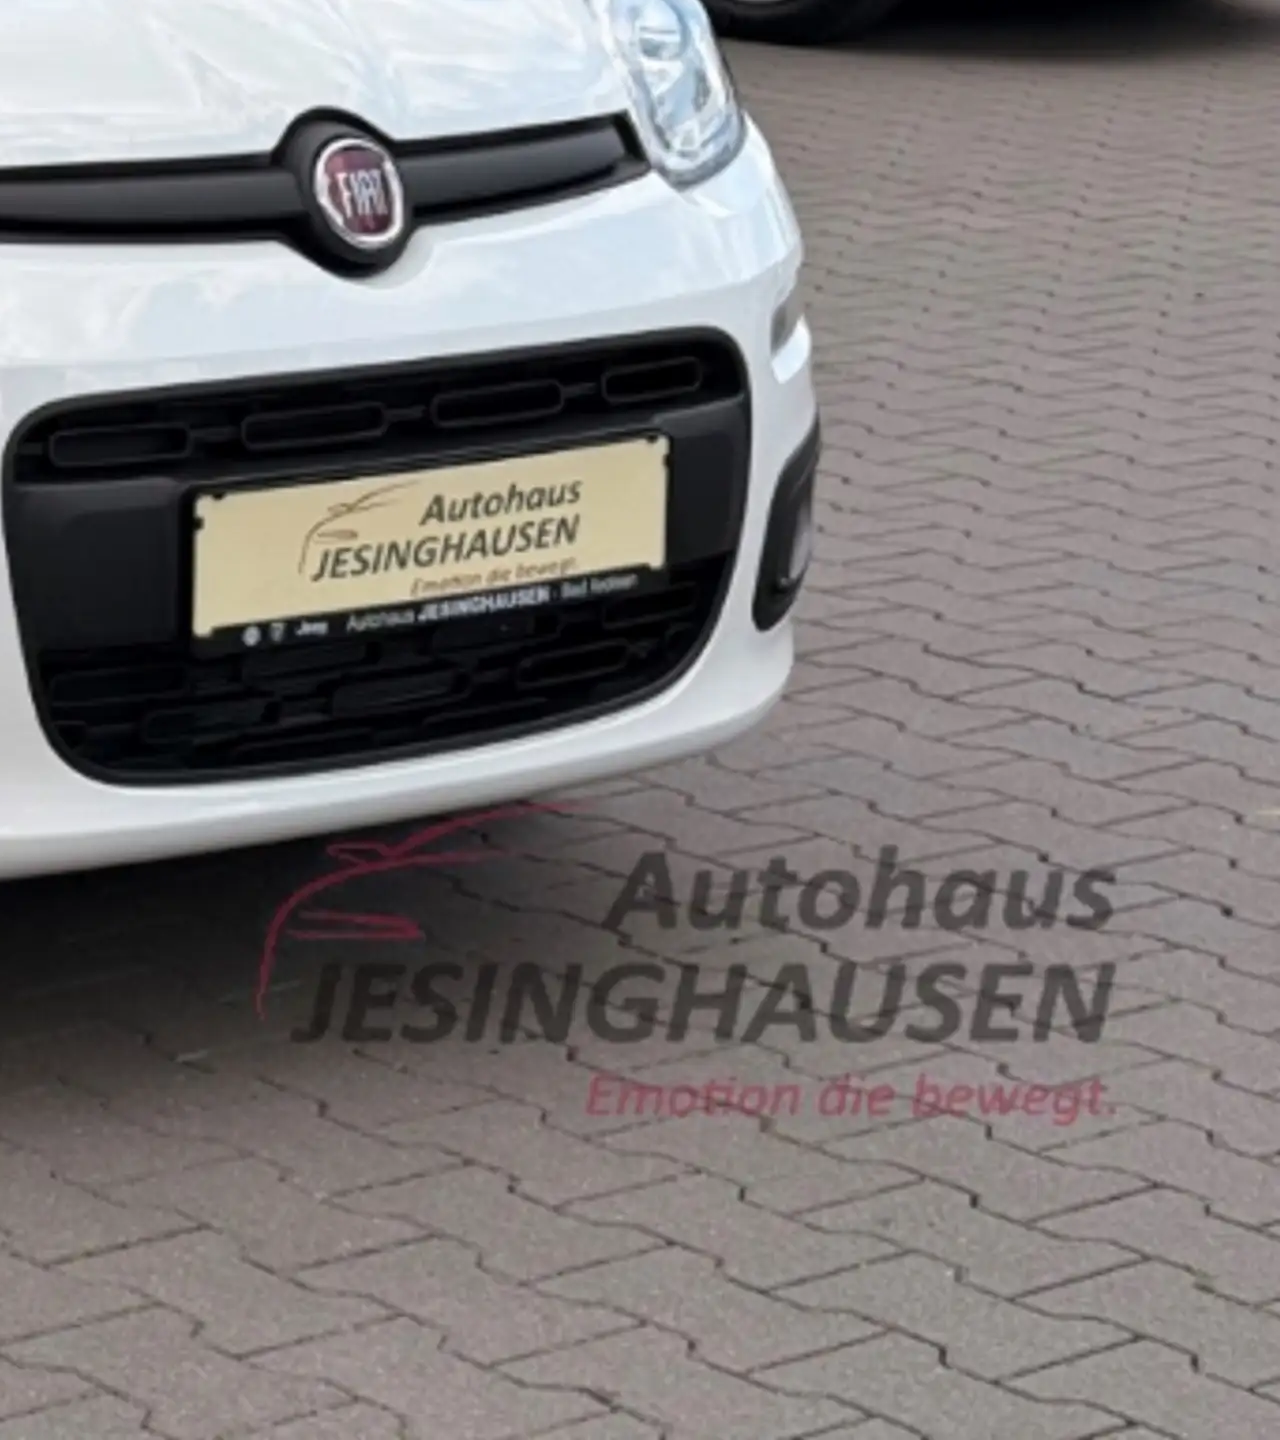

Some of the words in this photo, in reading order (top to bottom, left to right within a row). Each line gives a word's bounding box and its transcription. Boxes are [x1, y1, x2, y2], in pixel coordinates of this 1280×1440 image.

[335, 168, 389, 219] FIAT
[419, 479, 583, 528] Autohaus
[311, 514, 581, 582] JESINGHAUSEN
[416, 584, 551, 624] JESINGHAUSEN
